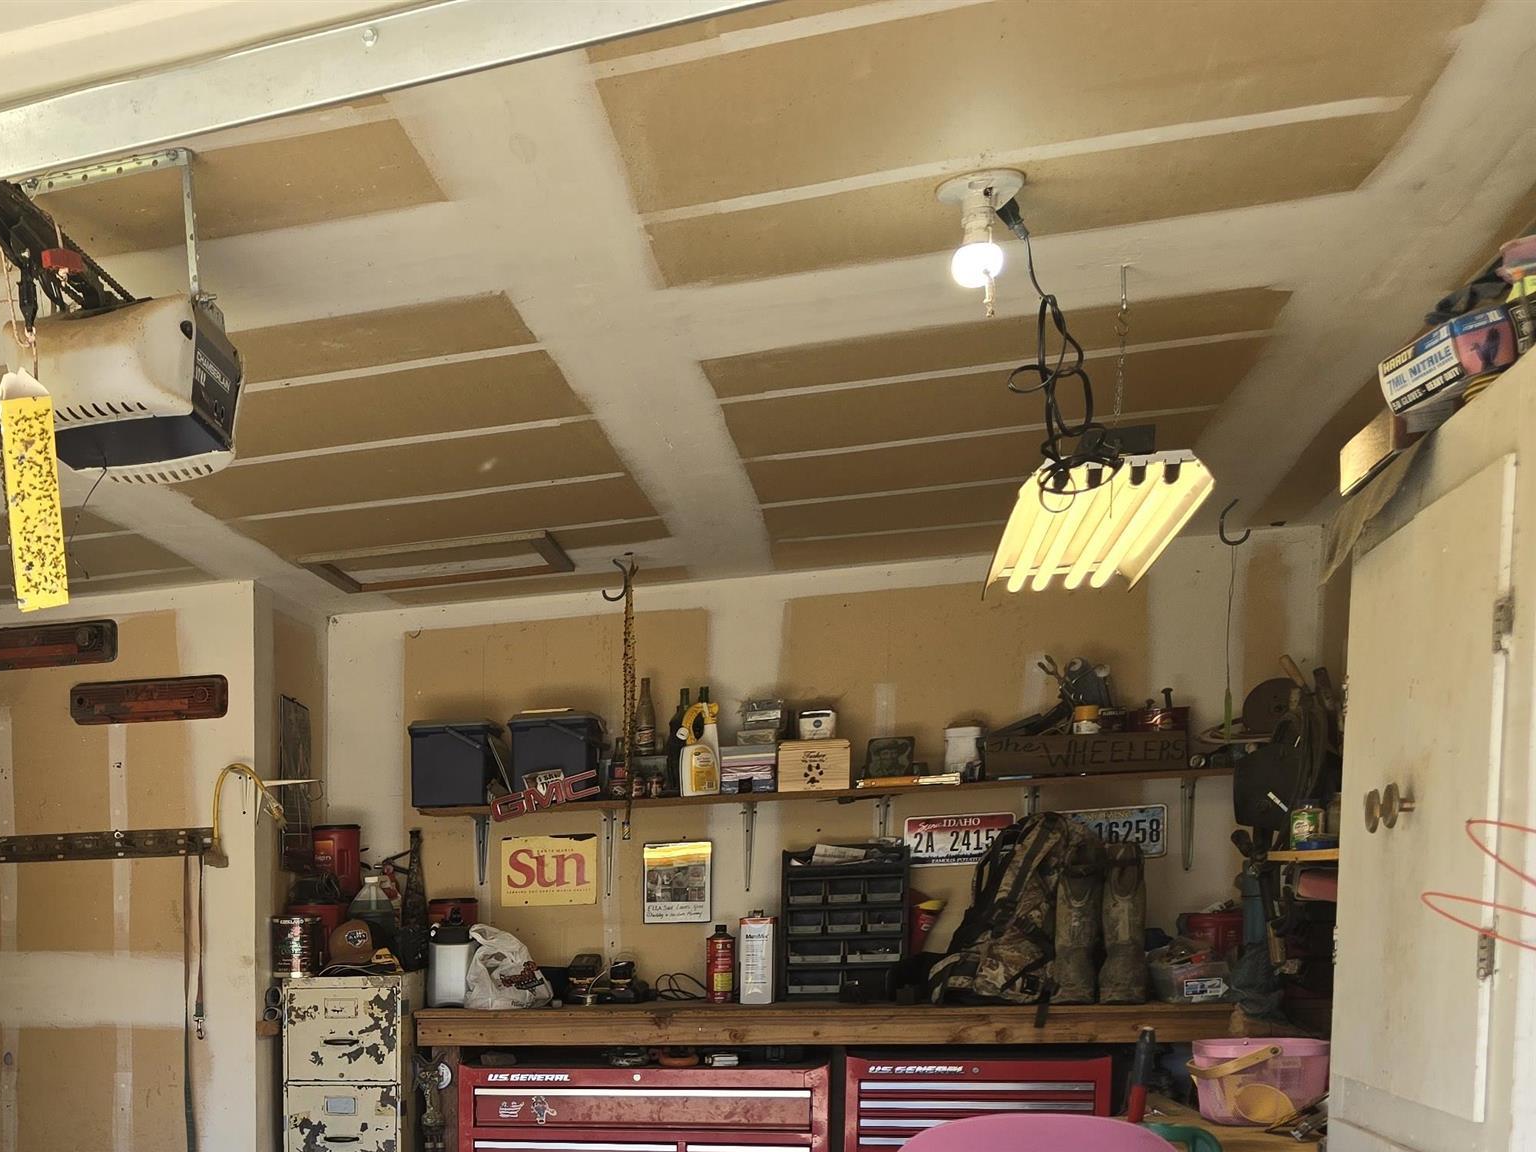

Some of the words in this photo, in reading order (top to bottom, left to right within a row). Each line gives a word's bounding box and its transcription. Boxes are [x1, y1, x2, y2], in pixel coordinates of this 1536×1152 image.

[1408, 346, 1453, 378] NITRILE
[1041, 739, 1187, 769] WHEELERS
[491, 769, 601, 823] GMC
[943, 817, 981, 828] IDAHO
[1095, 818, 1161, 843] 16258
[913, 832, 935, 853] 2A
[507, 848, 591, 888] Sun
[510, 1073, 571, 1081] GENERAL
